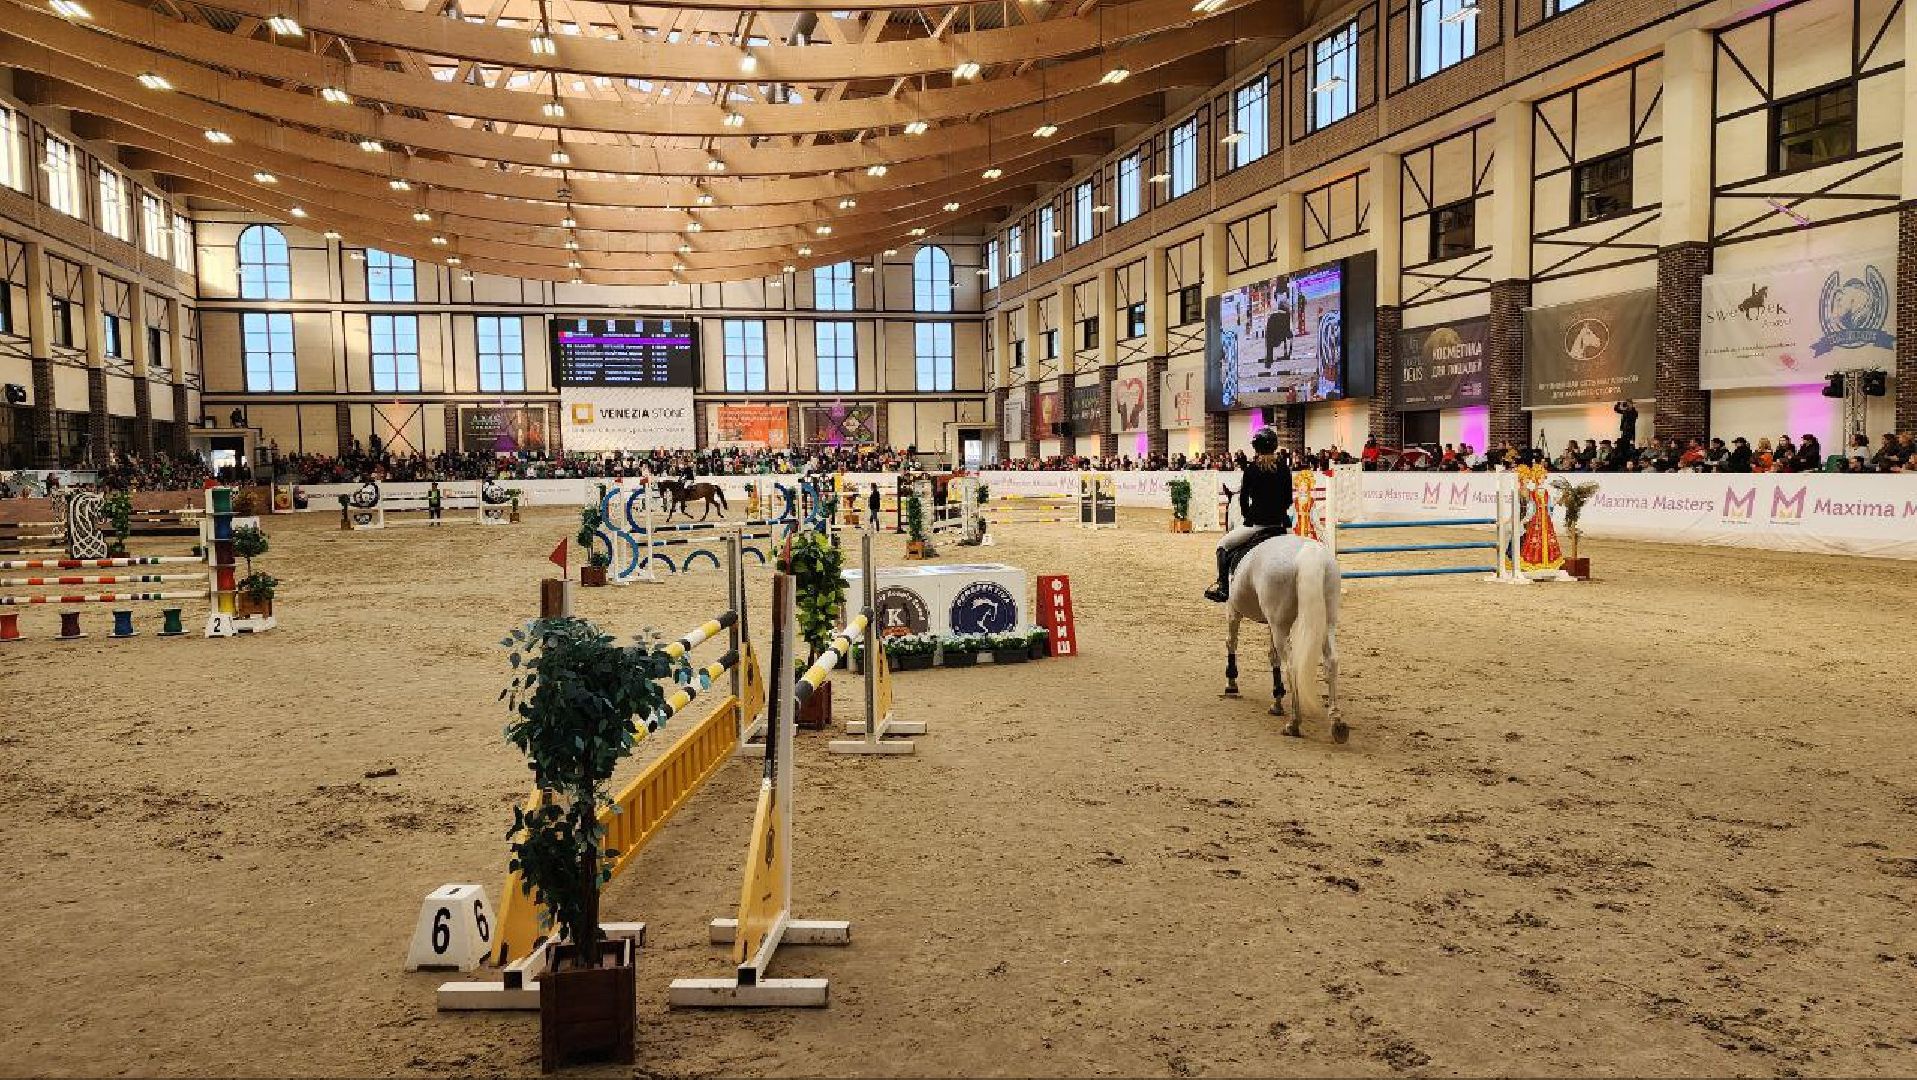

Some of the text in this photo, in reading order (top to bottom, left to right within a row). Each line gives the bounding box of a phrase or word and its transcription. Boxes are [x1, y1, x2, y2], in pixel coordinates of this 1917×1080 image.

[1432, 341, 1482, 361] КОСМЕТИКА
[600, 407, 685, 419] VENEZIA STONE
[1593, 492, 1714, 512] Maxima Masters
[1813, 497, 1895, 517] Maxima
[213, 617, 221, 633] 2
[1051, 578, 1071, 654] ФИНИШ
[432, 906, 451, 954] 6
[474, 900, 489, 943] 6
